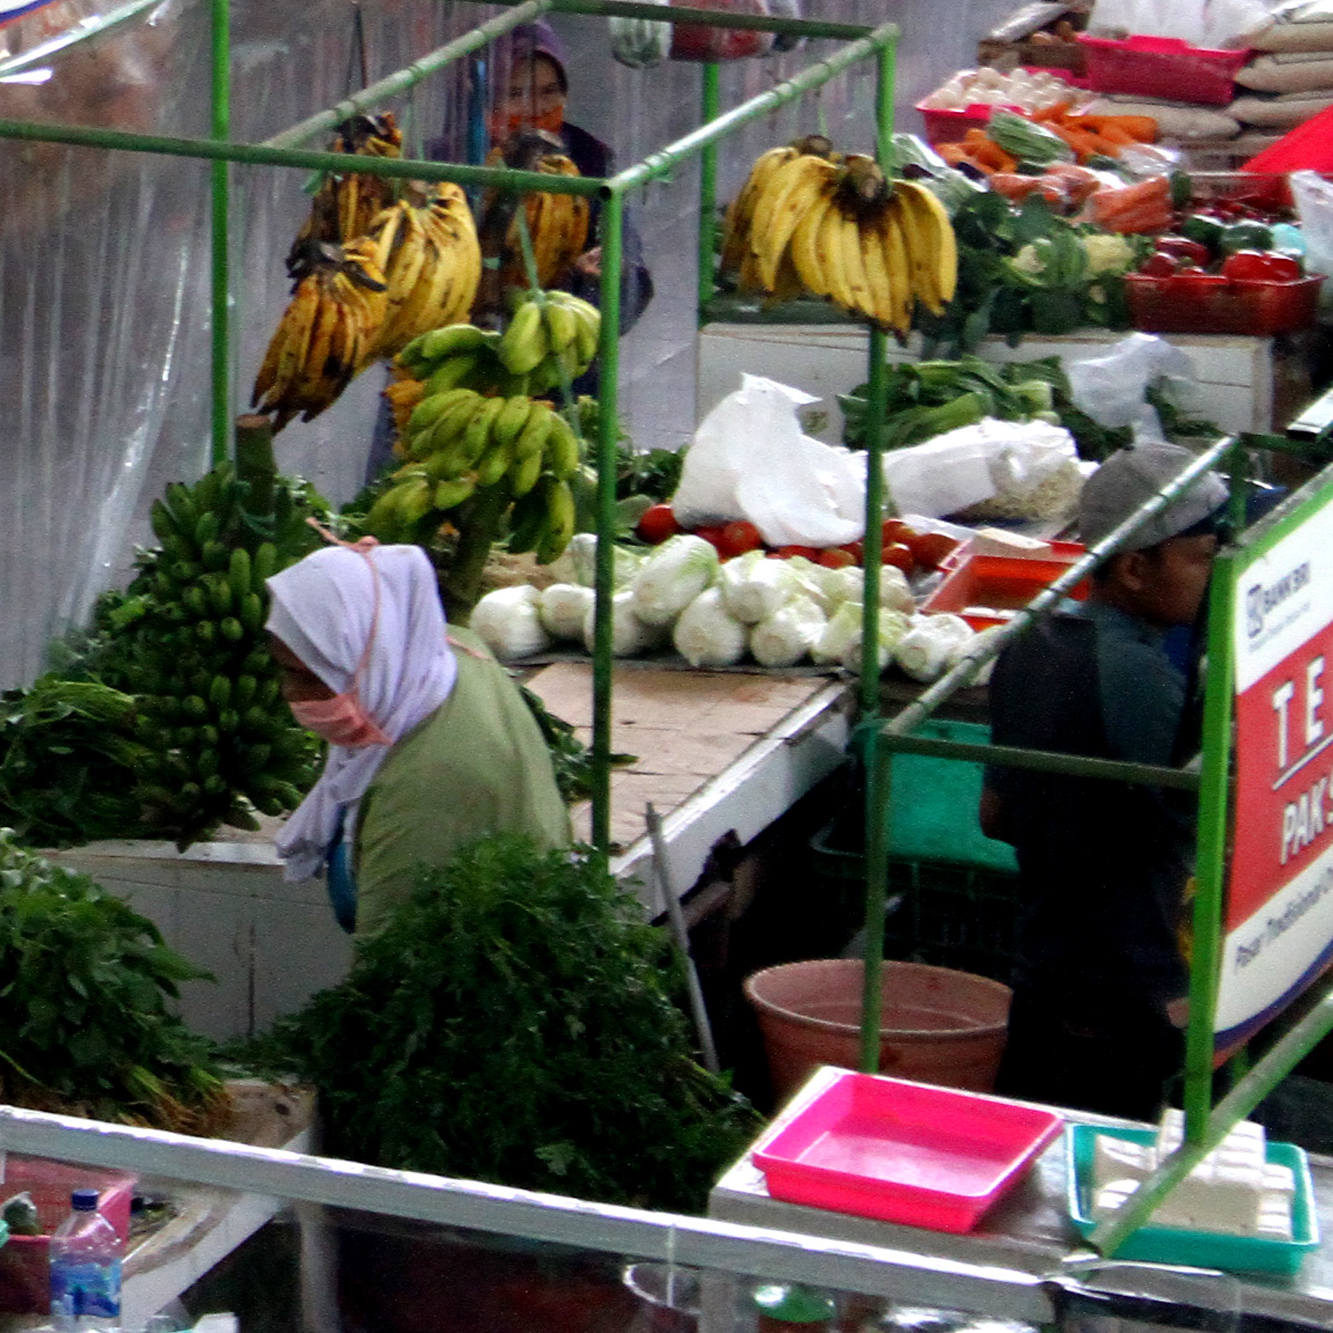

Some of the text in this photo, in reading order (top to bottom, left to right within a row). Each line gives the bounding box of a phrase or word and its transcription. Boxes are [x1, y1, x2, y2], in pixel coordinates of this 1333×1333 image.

[1263, 562, 1311, 614] BANK BRI
[1281, 778, 1327, 866] PAK
